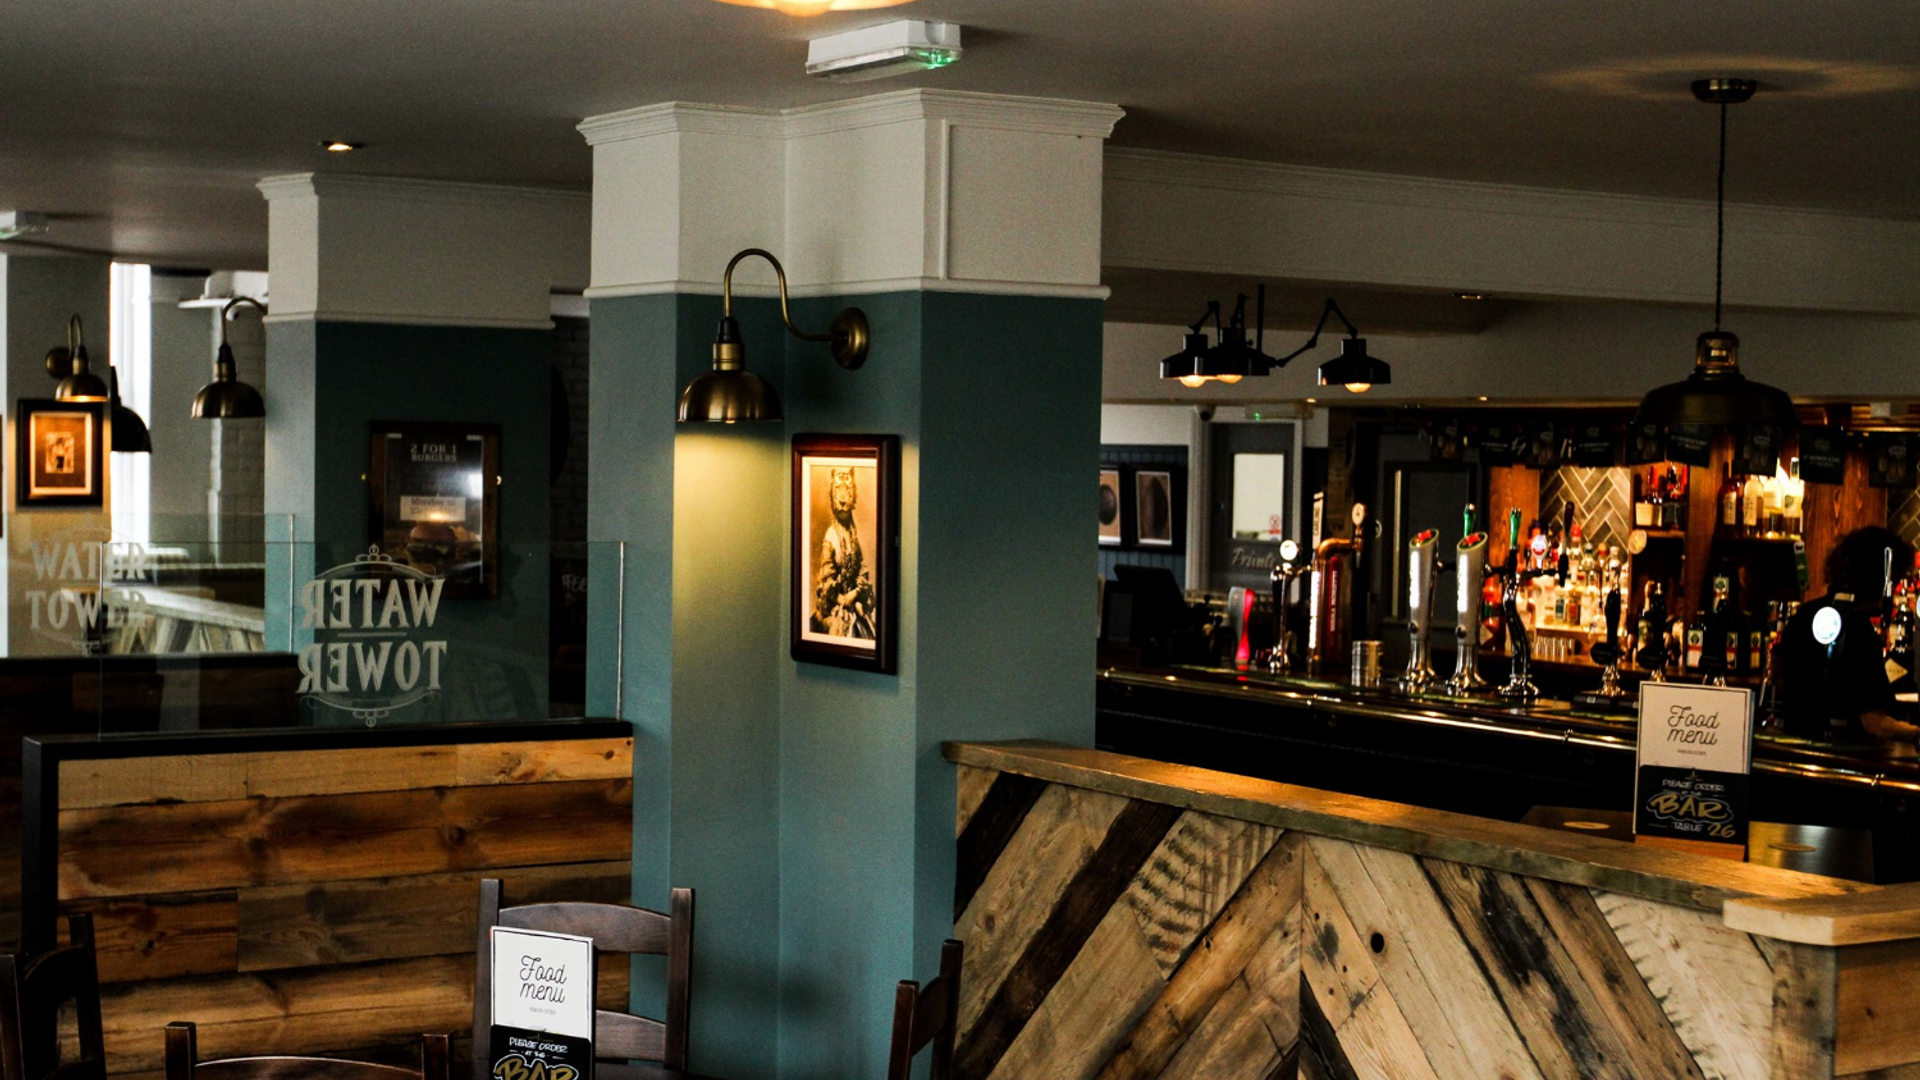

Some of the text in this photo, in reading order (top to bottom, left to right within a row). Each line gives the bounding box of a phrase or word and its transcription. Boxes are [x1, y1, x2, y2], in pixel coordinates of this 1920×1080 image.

[410, 443, 457, 454] 2 FOR 1
[30, 541, 148, 581] WATER
[25, 590, 148, 630] TOWER
[1667, 705, 1720, 730] Food
[1667, 728, 1718, 746] menu
[1650, 793, 1728, 819] BAR
[1672, 821, 1736, 838] TABLE 26
[520, 955, 567, 984] Food
[520, 982, 566, 1003] menu
[509, 1036, 568, 1053] PLEASE ORDER
